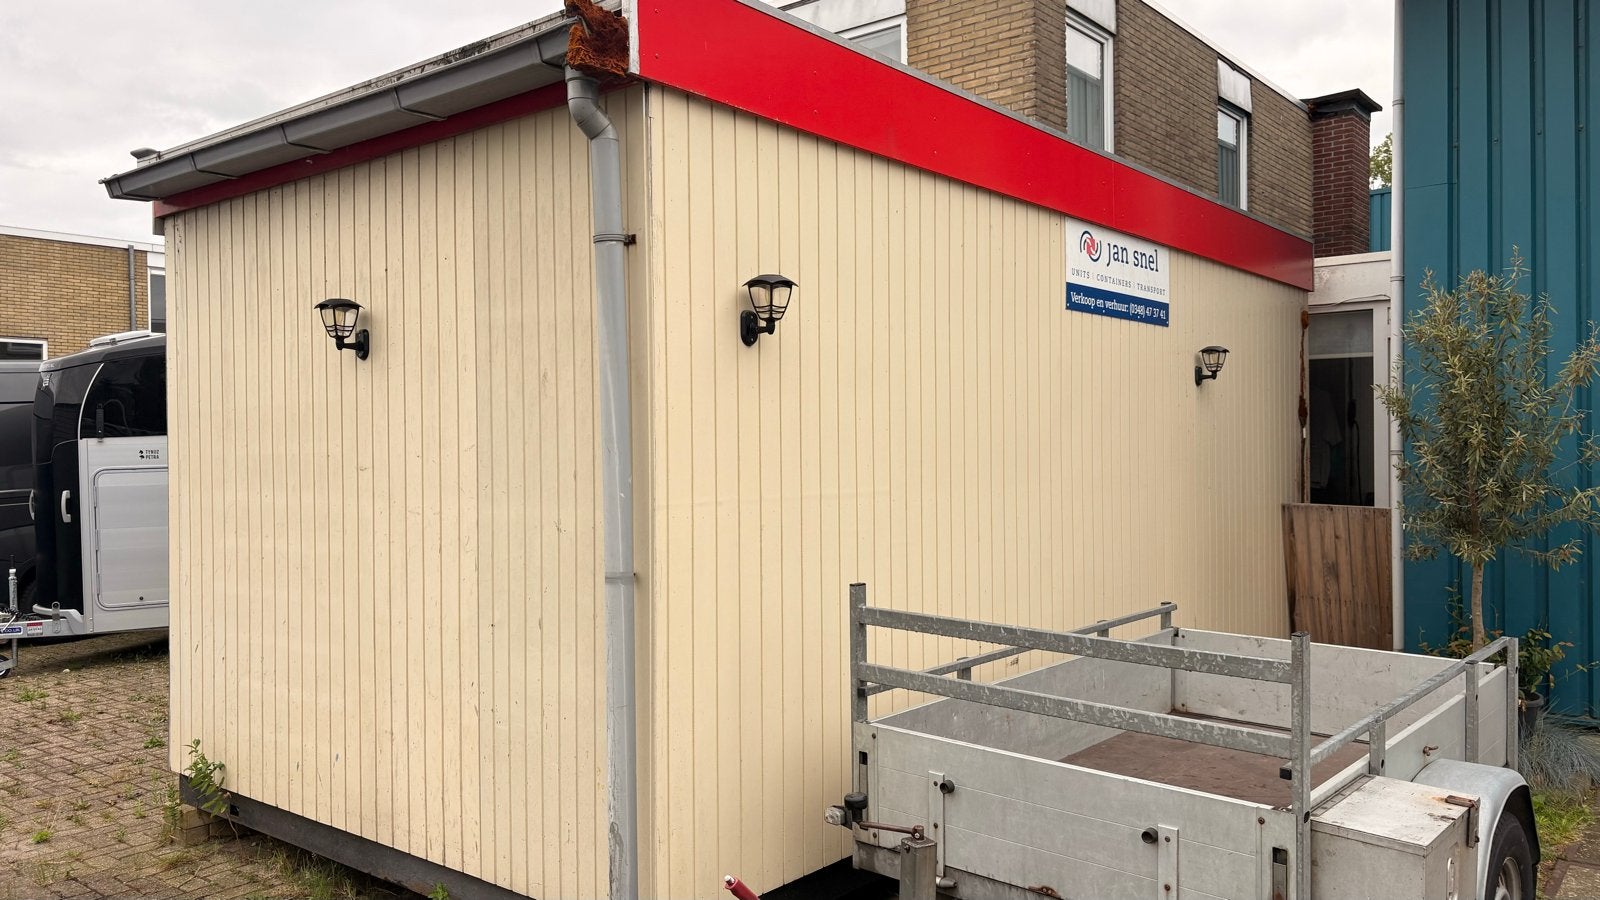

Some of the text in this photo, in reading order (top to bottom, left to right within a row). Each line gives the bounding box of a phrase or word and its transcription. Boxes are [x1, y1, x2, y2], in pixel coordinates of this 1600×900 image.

[1106, 243, 1159, 272] jan snel
[1071, 268, 1166, 296] UNITS CONTAINERS TRANSPORT
[1070, 292, 1095, 308] Verkoop
[1096, 299, 1104, 308] en
[1146, 307, 1152, 316] 47
[1153, 308, 1159, 318] 37
[1160, 310, 1166, 319] 41
